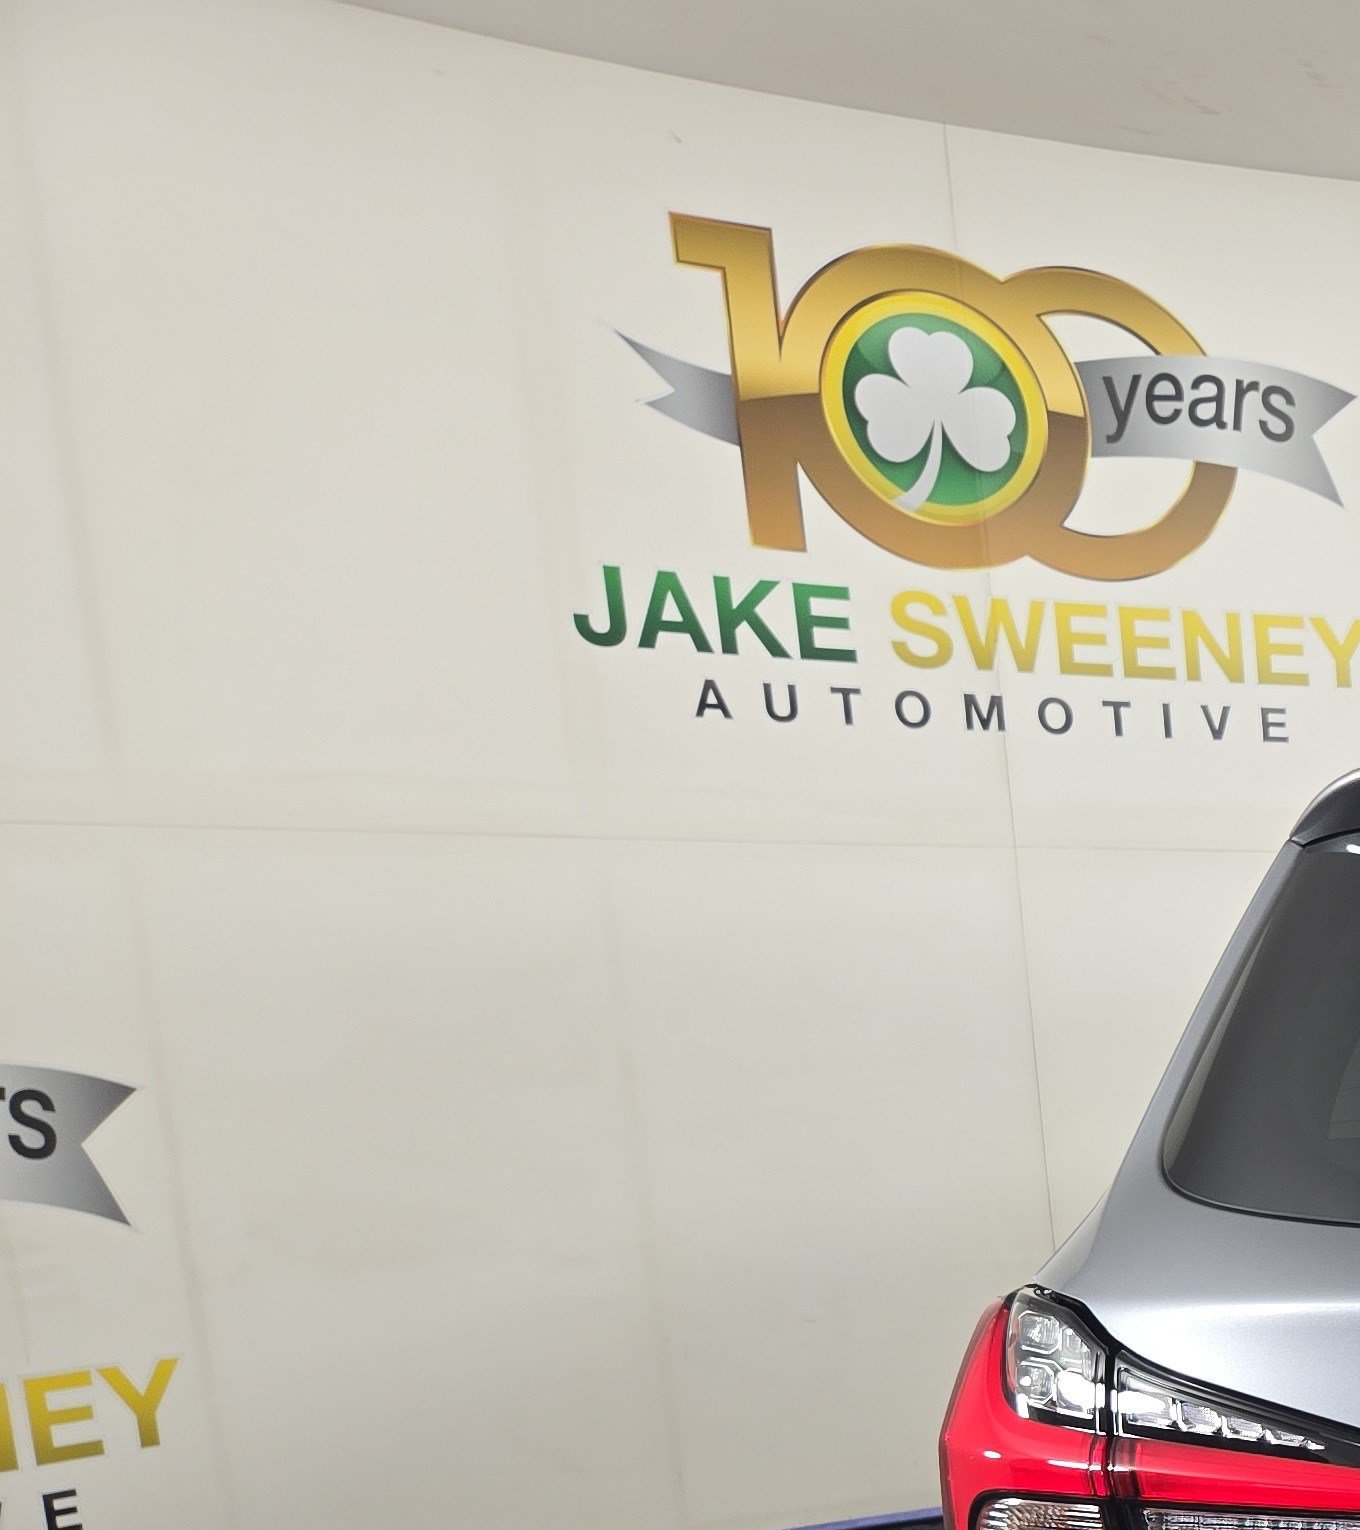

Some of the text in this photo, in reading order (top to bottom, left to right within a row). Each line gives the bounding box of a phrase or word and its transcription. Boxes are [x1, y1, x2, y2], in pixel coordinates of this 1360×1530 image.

[668, 211, 1239, 582] 100
[1101, 371, 1298, 443] years
[572, 564, 858, 664] JAKE
[694, 678, 1290, 743] AUTOMOTIVE
[0, 1357, 180, 1473] EY
